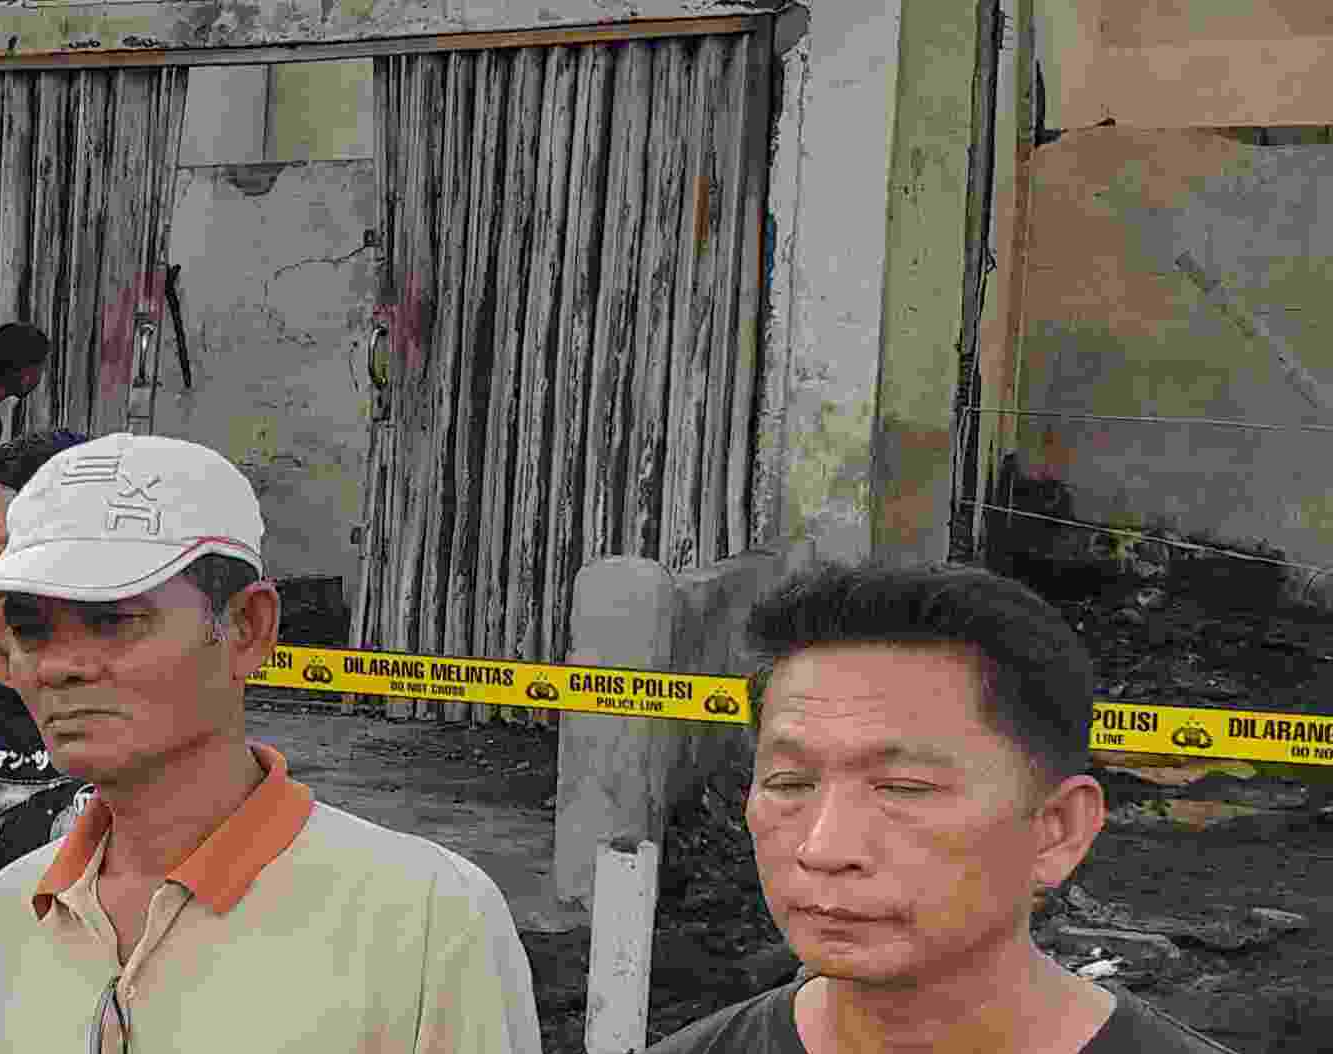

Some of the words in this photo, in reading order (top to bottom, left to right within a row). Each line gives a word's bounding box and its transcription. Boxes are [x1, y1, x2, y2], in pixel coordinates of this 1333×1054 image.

[343, 655, 426, 680] DILARANG
[429, 663, 515, 687] MELINTAS
[568, 672, 626, 696] GARIS
[631, 678, 694, 701] POLISI
